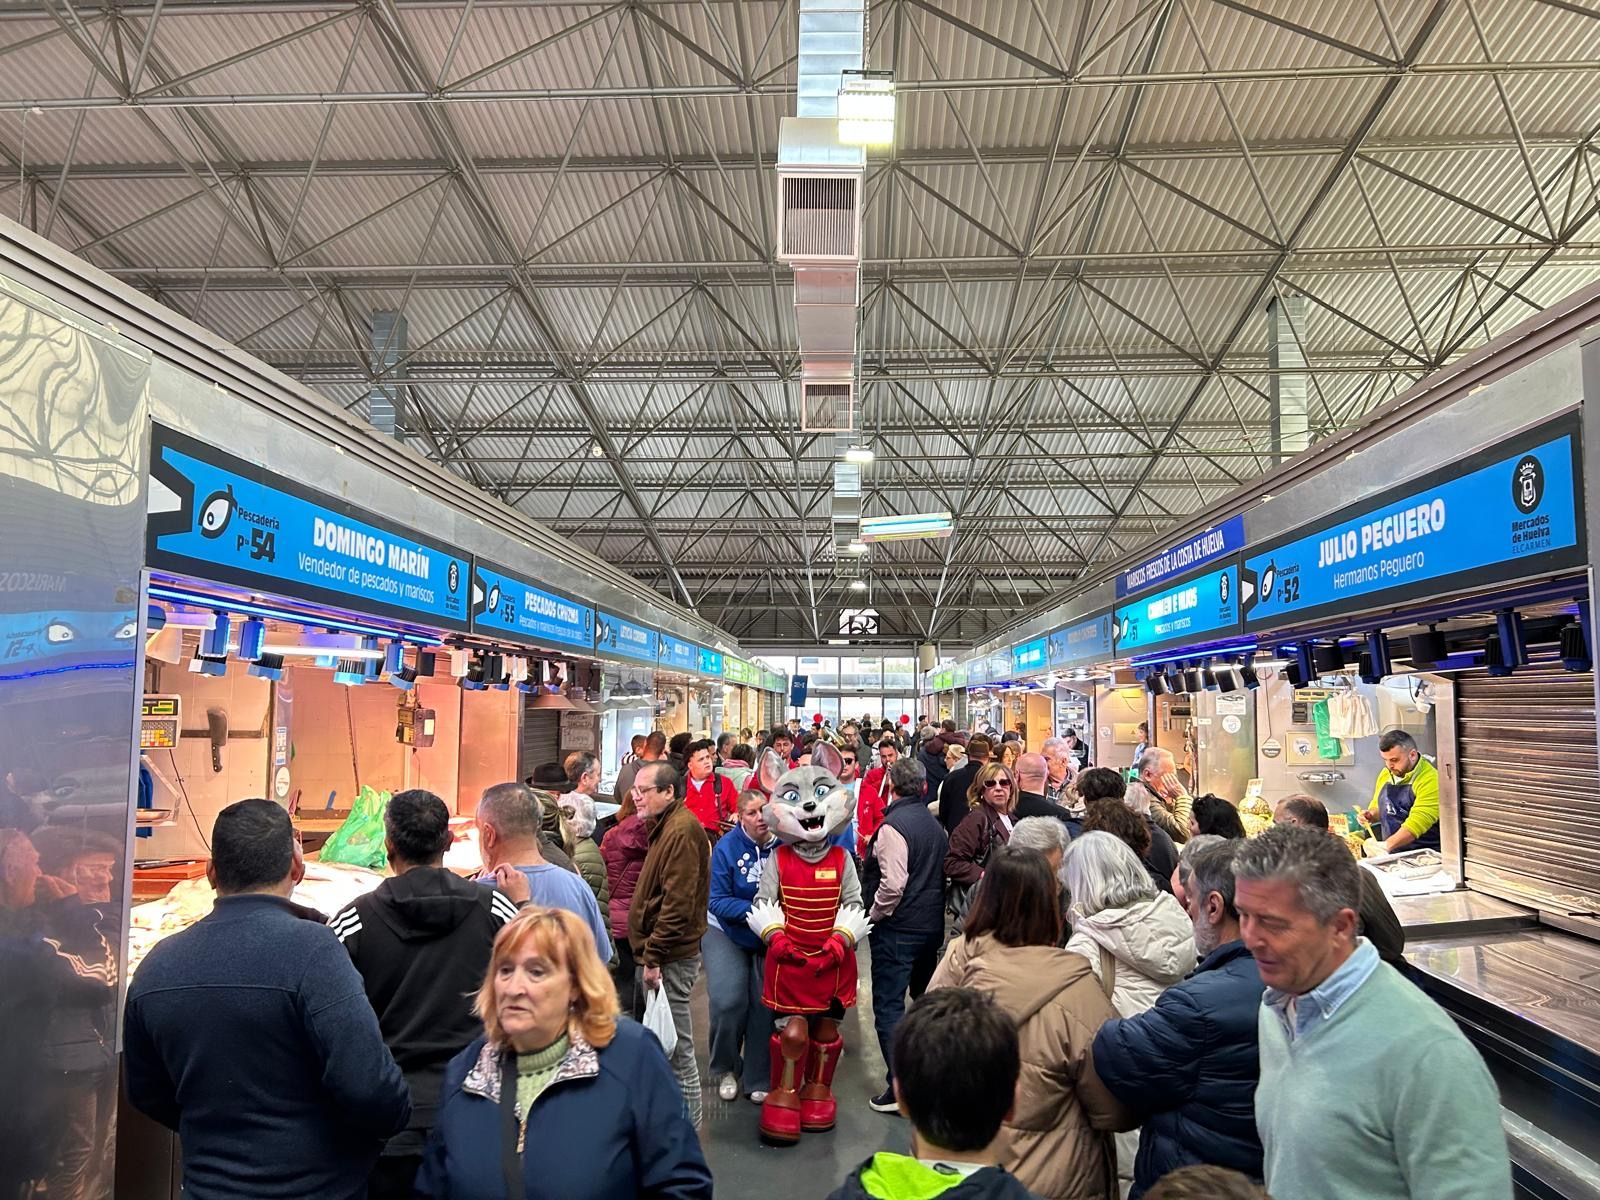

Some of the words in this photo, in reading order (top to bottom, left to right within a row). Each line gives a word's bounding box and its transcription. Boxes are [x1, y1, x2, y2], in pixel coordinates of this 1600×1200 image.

[1318, 530, 1357, 568] JULIO
[1361, 498, 1446, 554] PEGUERO
[1511, 514, 1550, 532] Mercados
[1512, 532, 1522, 544] de
[1522, 526, 1550, 541] Huelva
[250, 527, 275, 562] 54
[313, 517, 385, 566] DOMINGO
[388, 544, 430, 580] MARÍN
[1126, 566, 1146, 590] MARISCOS
[1146, 557, 1164, 581] FRESCOS
[1163, 554, 1171, 573] DE
[1170, 551, 1178, 571] LA
[1177, 544, 1194, 568] COSTA
[1193, 540, 1202, 560] DE
[1201, 529, 1225, 557] HUELVA
[298, 551, 347, 580] Vendedor
[348, 566, 360, 584] de
[361, 572, 398, 594] pescados
[399, 583, 405, 598] y
[404, 584, 435, 604] mariscos
[1333, 563, 1379, 590] Hermanos
[1380, 551, 1425, 577] Peguero
[524, 591, 557, 618] PESCADOS
[1284, 576, 1300, 604] 52
[504, 603, 515, 624] 55
